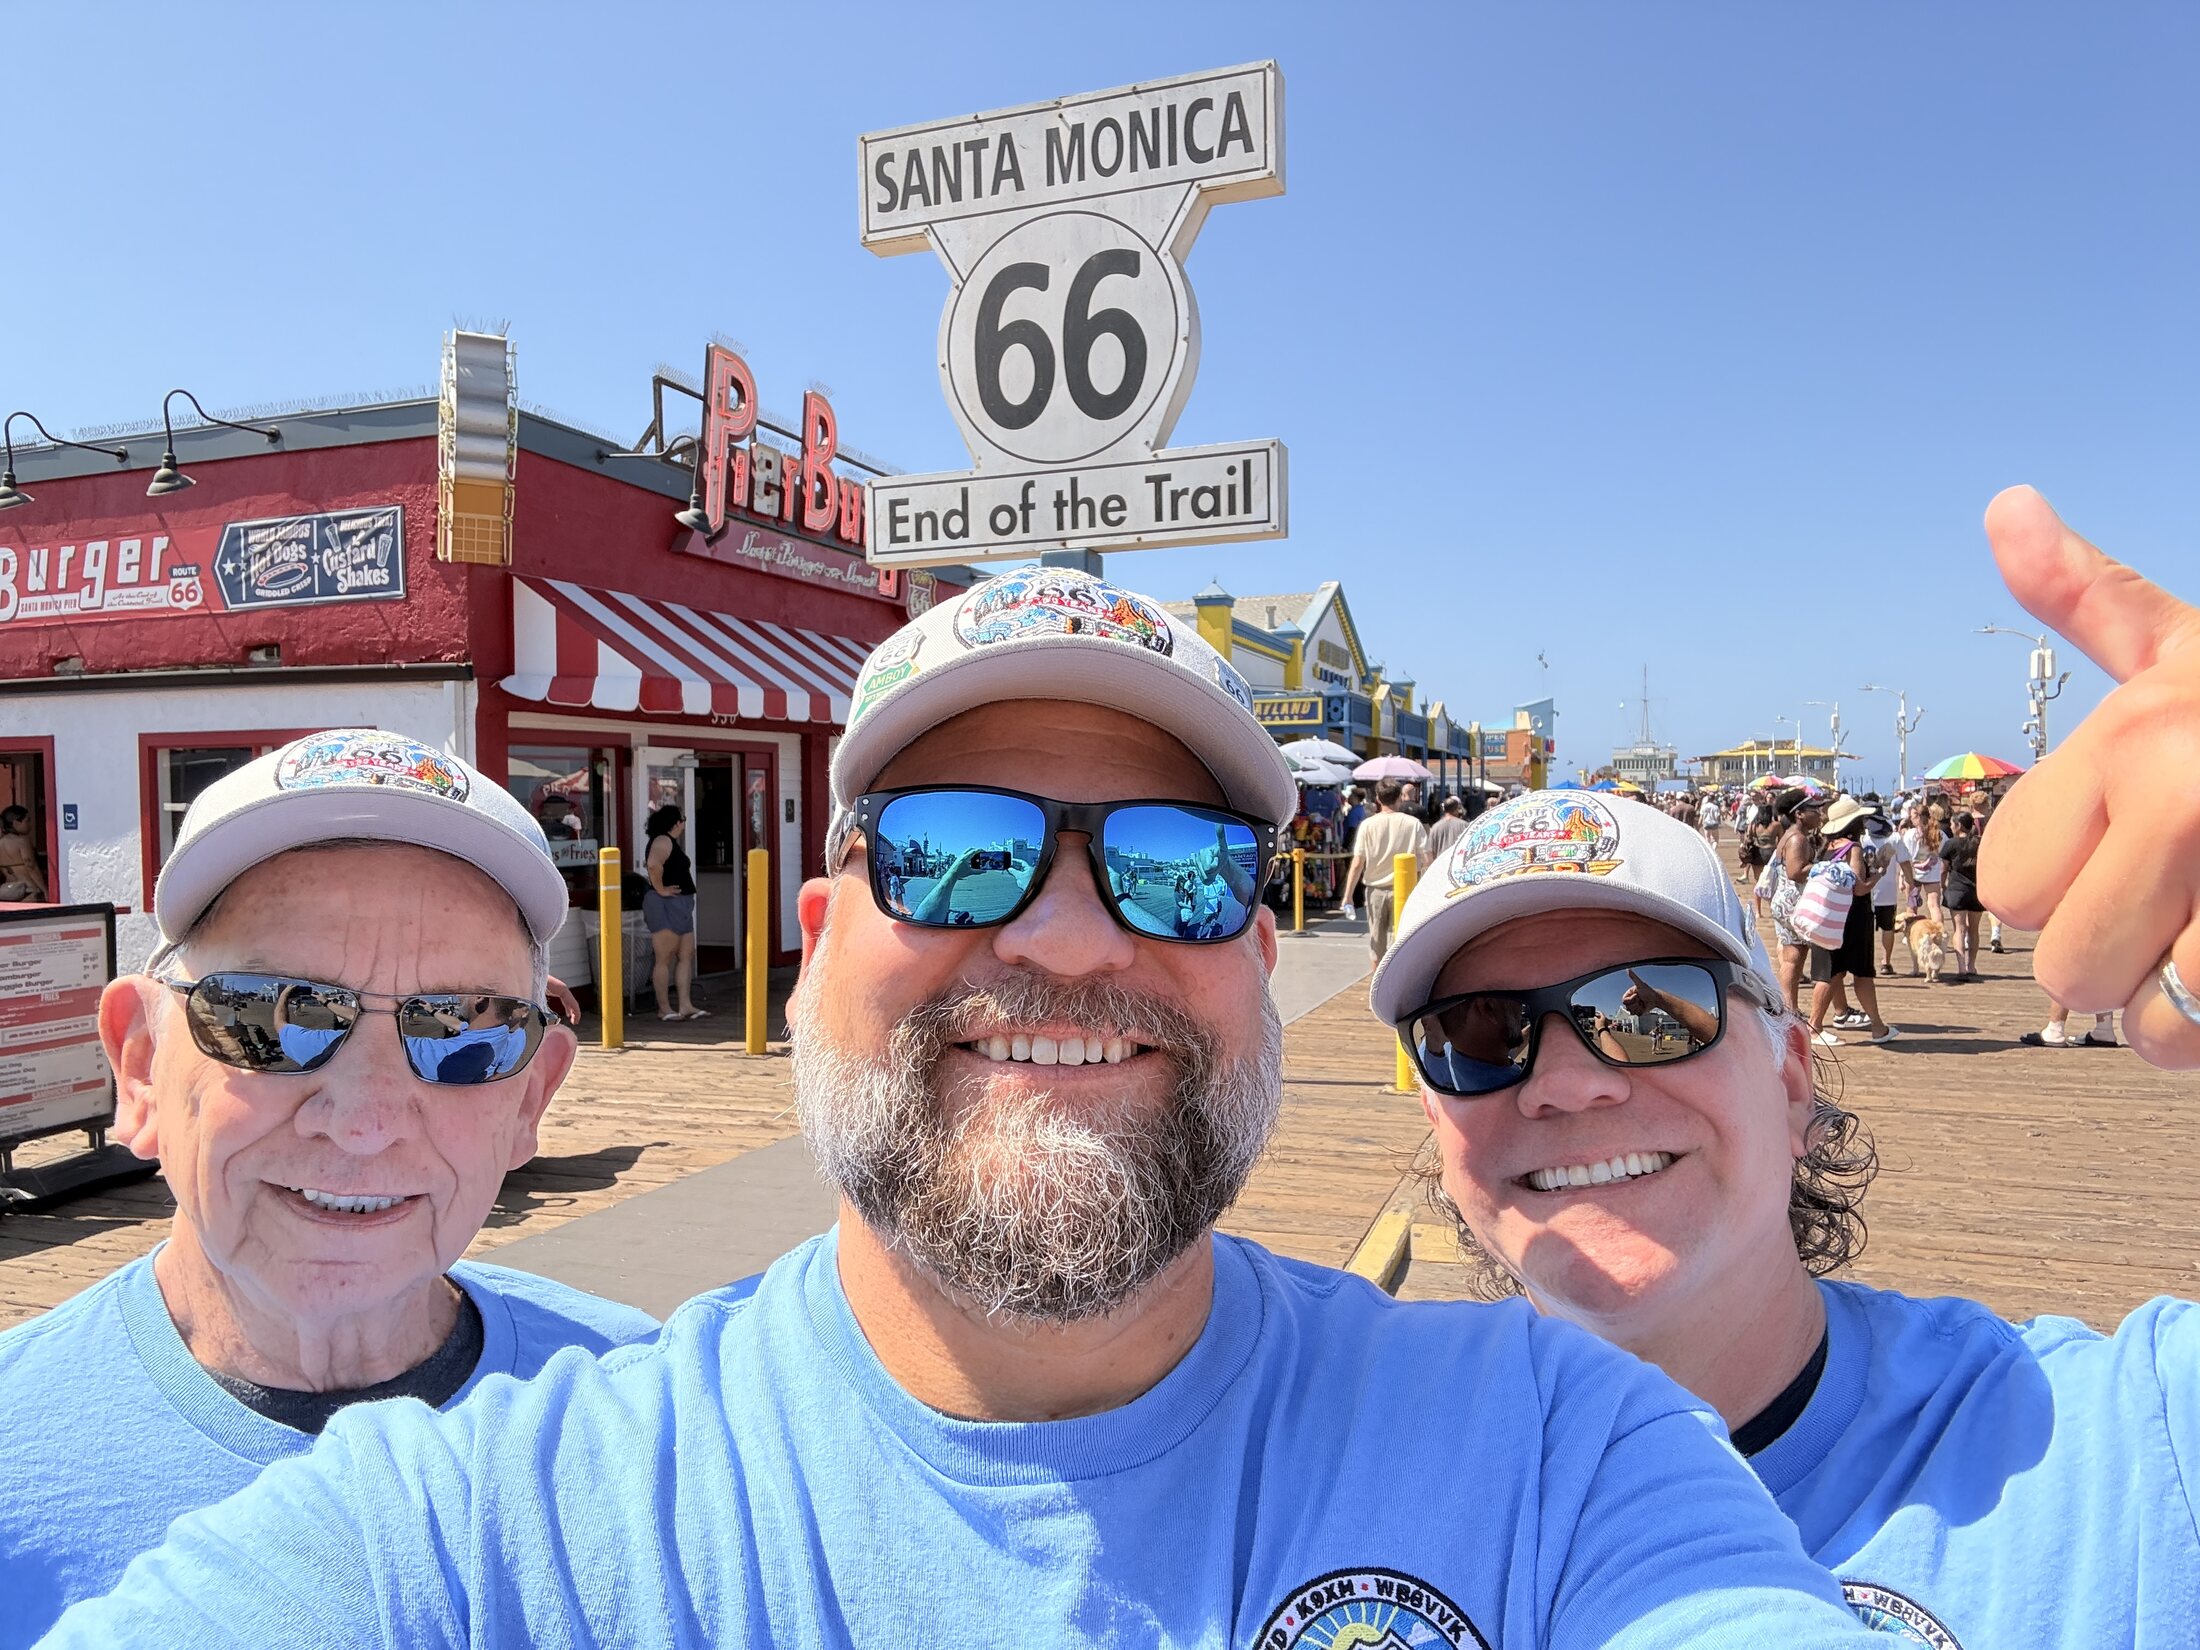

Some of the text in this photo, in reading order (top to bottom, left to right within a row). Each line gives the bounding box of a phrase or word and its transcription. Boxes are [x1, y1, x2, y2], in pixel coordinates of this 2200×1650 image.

[875, 90, 1255, 214] SANTA MONICA
[974, 248, 1149, 431] 66
[889, 458, 1253, 545] End of the Trail
[248, 523, 311, 544] WORLD FAMOUS
[340, 515, 394, 532] DELICIOUS TREAT
[251, 541, 307, 587] Hot Dogs
[323, 537, 376, 577] Custard
[0, 536, 170, 622] Burger
[172, 566, 197, 576] ROUTE
[336, 565, 390, 593] Shakes
[171, 581, 198, 603] 66
[255, 576, 312, 597] GRIDDLED CRISP
[21, 598, 77, 613] SANTA MONICA PIER
[868, 664, 908, 691] AMBOY
[1226, 679, 1245, 703] 66
[1255, 702, 1311, 715] AYLAND
[1507, 816, 1550, 834] 66
[1522, 830, 1556, 840] YEARS
[25, 979, 54, 987] Burger
[1296, 1579, 1354, 1619] K9XH
[1873, 1591, 1949, 1649] WB8VVK
